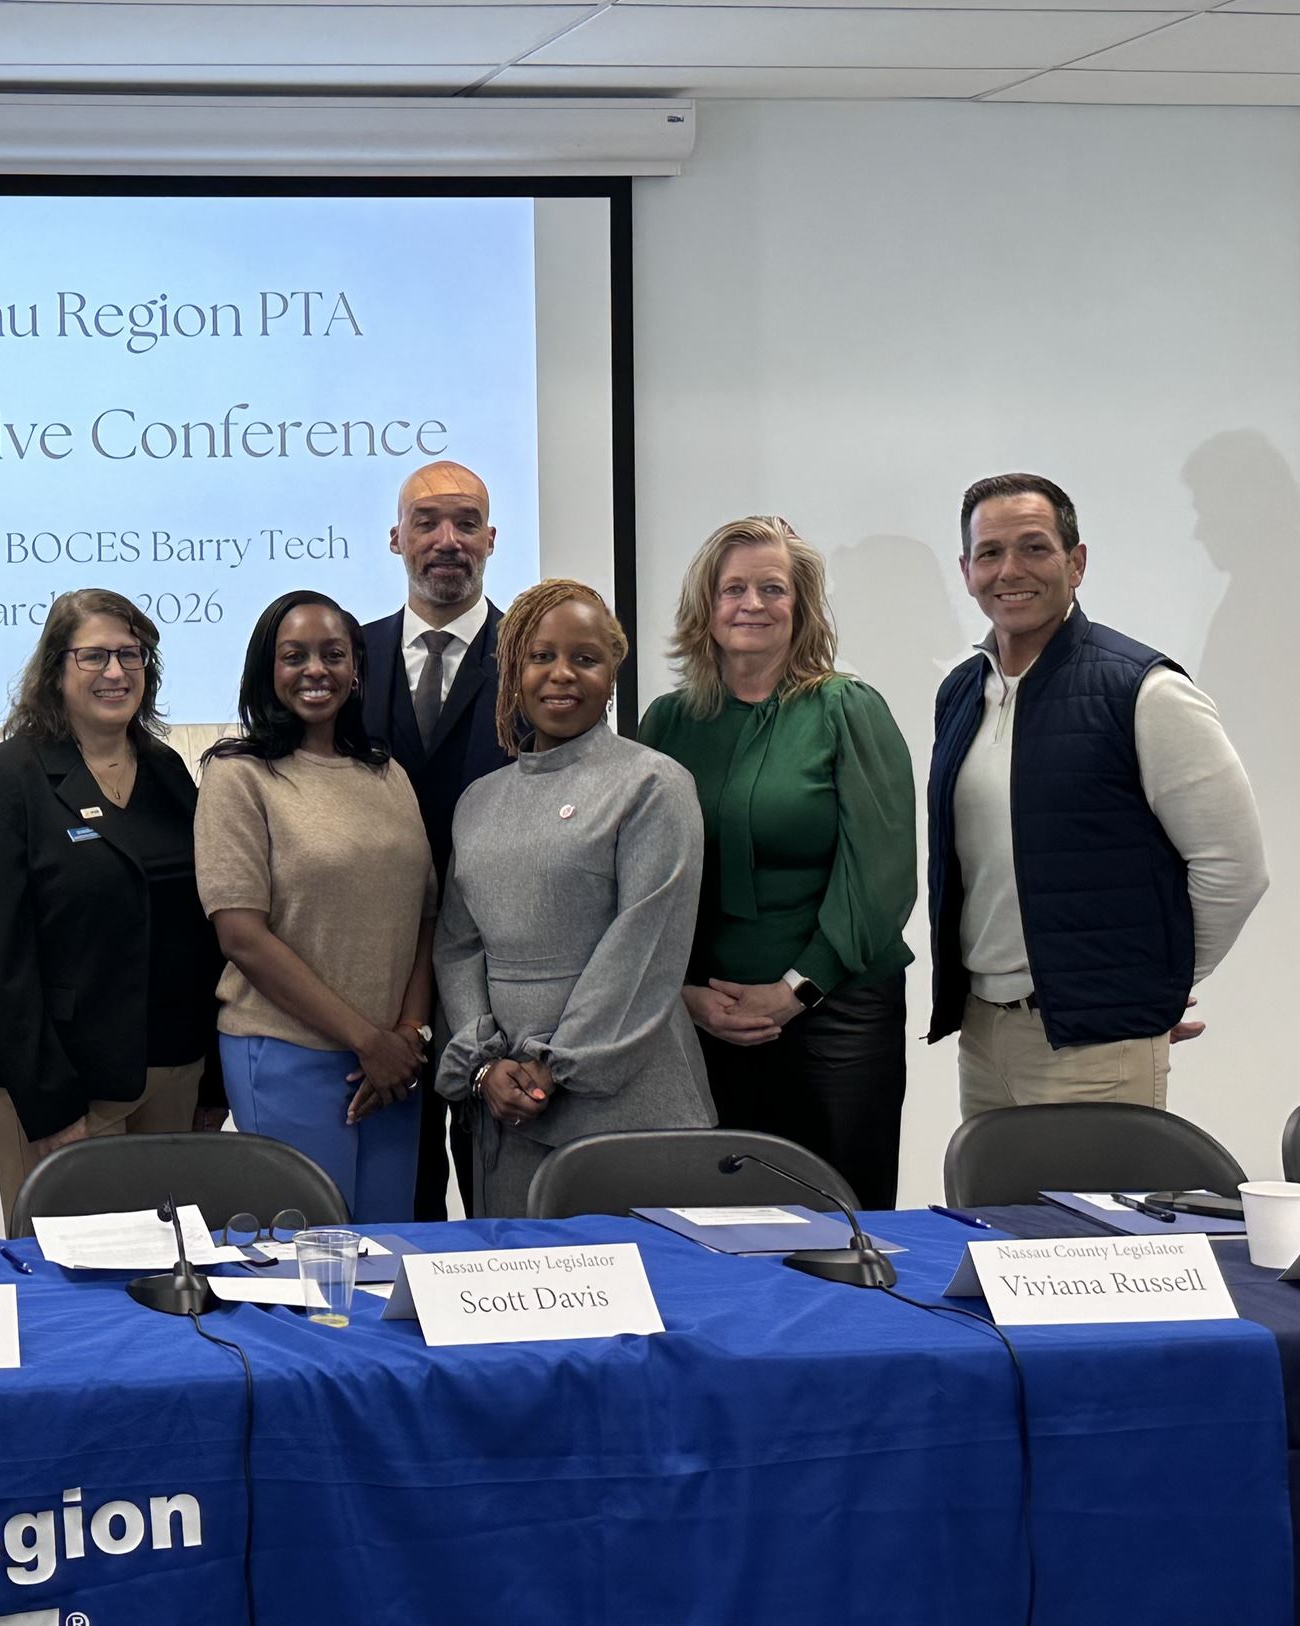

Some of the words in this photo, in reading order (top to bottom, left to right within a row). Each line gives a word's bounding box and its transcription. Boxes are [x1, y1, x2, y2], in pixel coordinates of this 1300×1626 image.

[56, 291, 243, 355] Region
[259, 291, 364, 337] PTA
[91, 403, 449, 459] Conference
[6, 530, 141, 564] BOCES
[151, 531, 252, 569] Barry
[259, 524, 350, 561] Tech
[137, 589, 224, 624] 2026
[430, 1260, 484, 1275] Nassau
[487, 1257, 541, 1274] County
[544, 1252, 615, 1273] Legislator
[996, 1245, 1052, 1260] Nassau
[1053, 1244, 1109, 1261] County
[1112, 1241, 1185, 1260] Legislator
[998, 1274, 1107, 1297] Viviana
[1108, 1268, 1207, 1294] Russell
[460, 1290, 529, 1314] Scott
[532, 1285, 609, 1310] Davis
